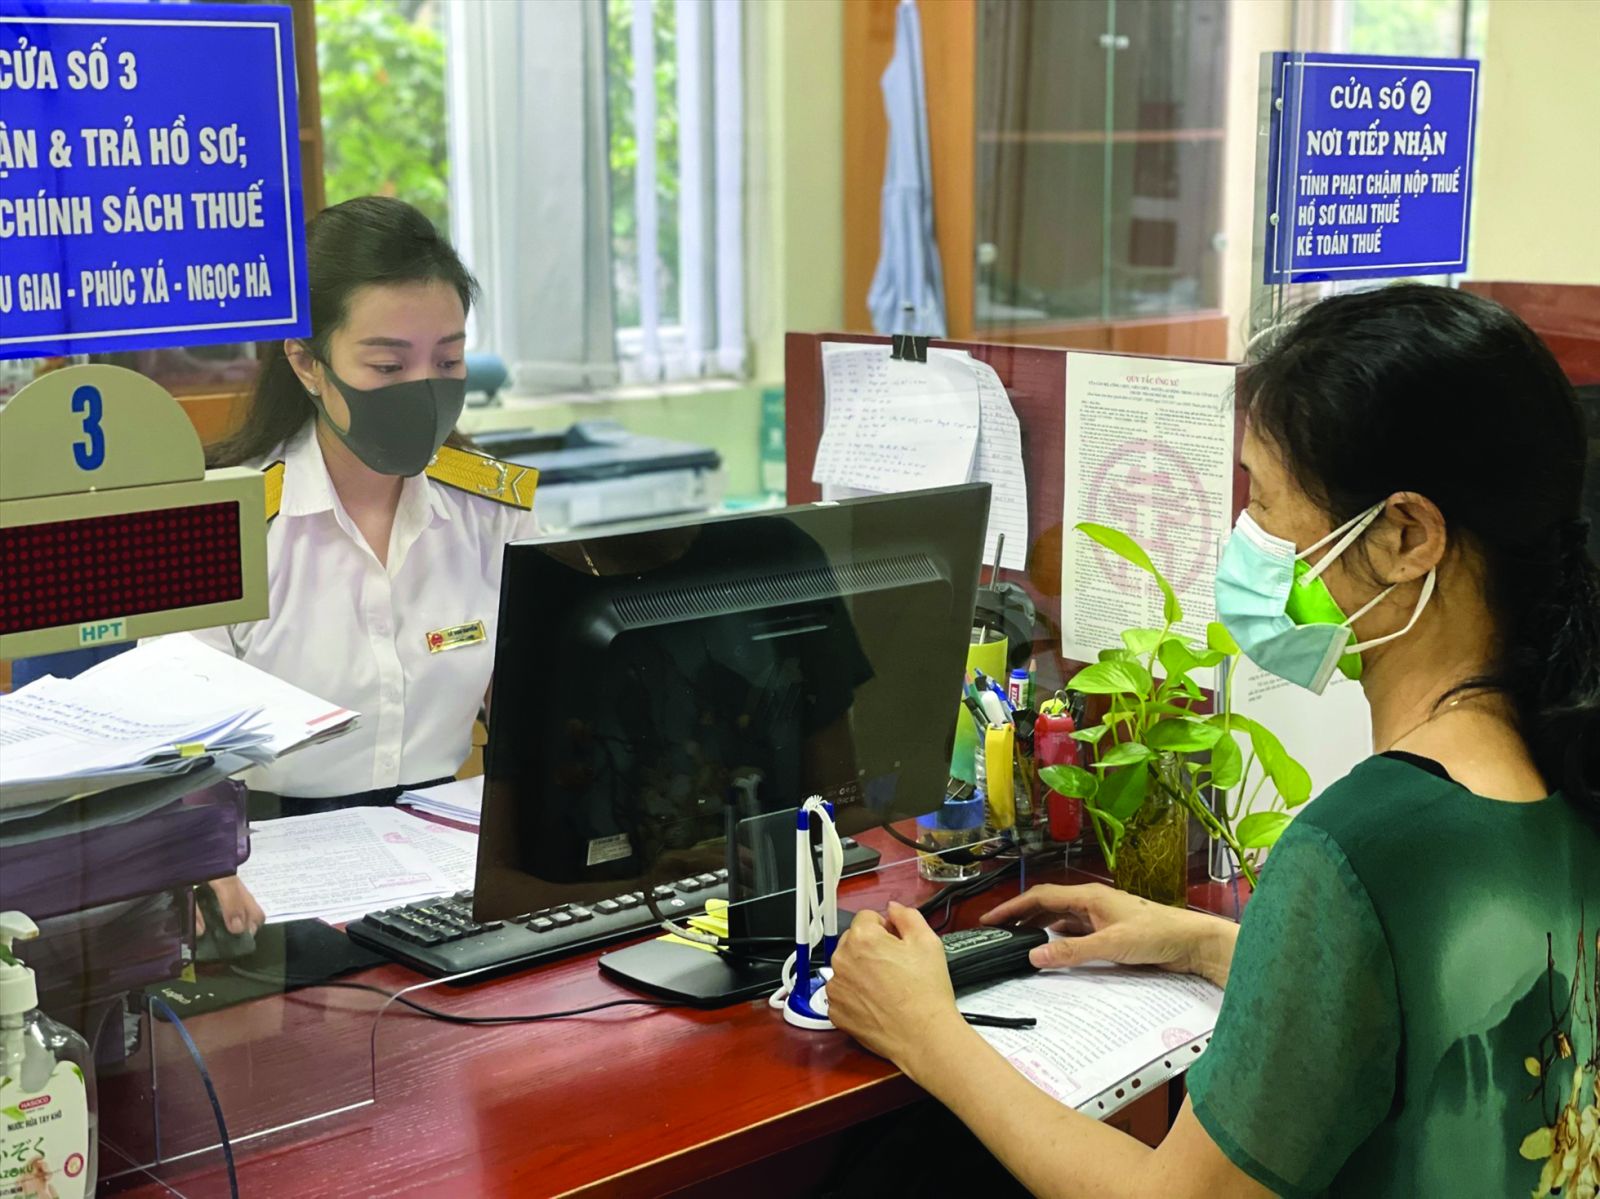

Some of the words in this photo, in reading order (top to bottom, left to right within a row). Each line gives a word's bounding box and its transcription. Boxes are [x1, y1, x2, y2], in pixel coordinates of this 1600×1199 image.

[0, 36, 59, 90] CỬA
[66, 36, 109, 90] SỐ
[117, 50, 138, 90] 3
[1329, 76, 1373, 110] CỬA
[1378, 76, 1408, 110] SỐ
[48, 129, 73, 169] &
[80, 114, 142, 167] TRẢ
[149, 114, 190, 166] HỒ
[199, 123, 247, 169] SƠ;
[1306, 127, 1343, 157] NƠI
[1346, 118, 1390, 156] TIẾP
[1392, 123, 1448, 162] NHẬN
[1299, 169, 1330, 196] TÍNH
[1331, 174, 1364, 200] PHẠT
[1365, 169, 1402, 200] CHẬM
[1403, 169, 1429, 199] NỘP
[1430, 165, 1462, 194] THUẾ
[0, 189, 93, 238] CHÍNH
[102, 186, 184, 234] SÁCH
[190, 179, 265, 230] THUẾ
[1297, 198, 1316, 227] HỒ
[1318, 201, 1338, 226] SƠ
[1338, 203, 1368, 225] KHAI
[1370, 194, 1401, 224] THUẾ
[1296, 226, 1314, 257] KẾ
[1316, 230, 1349, 256] TOÁN
[1351, 225, 1384, 254] THUẾ
[18, 271, 62, 312] GIAI
[80, 260, 136, 308] PHÚC
[140, 258, 170, 304] XÁ
[186, 262, 241, 308] NGỌC
[244, 254, 272, 299] HÀ
[72, 385, 105, 470] 3
[81, 622, 123, 641] HPT
